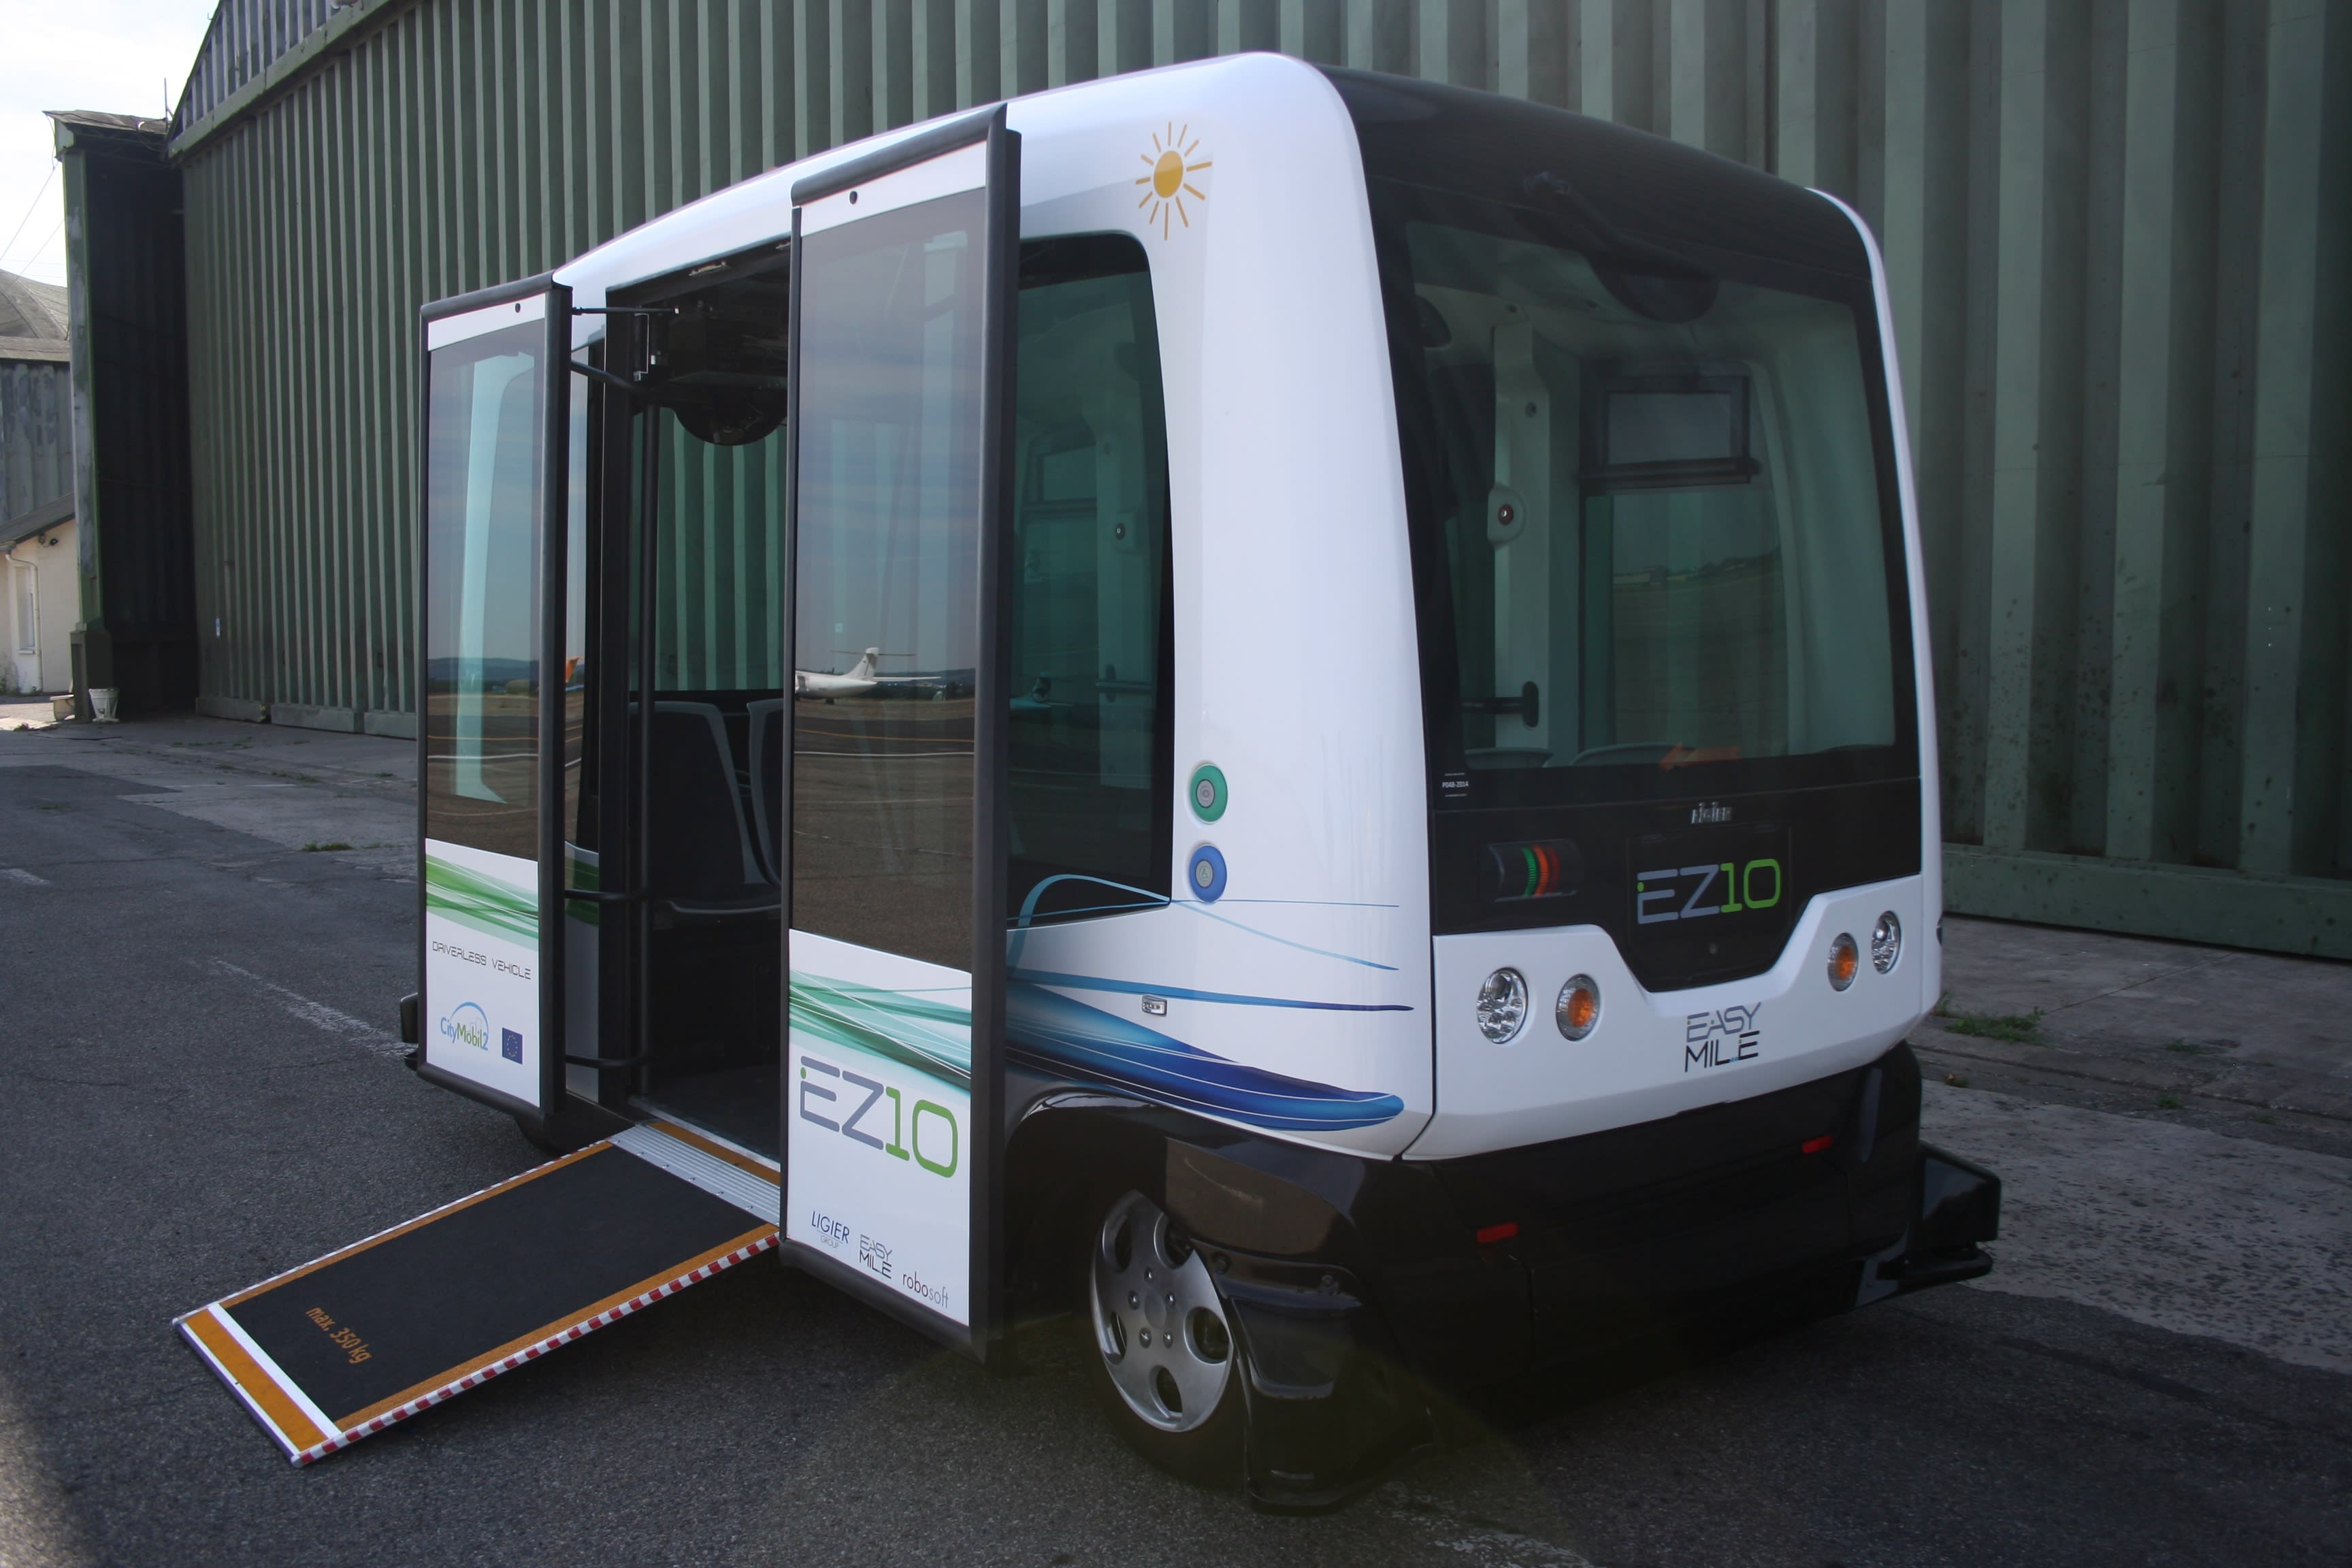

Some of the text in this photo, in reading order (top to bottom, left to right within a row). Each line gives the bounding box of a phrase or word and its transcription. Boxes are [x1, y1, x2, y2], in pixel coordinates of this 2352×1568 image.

[1637, 858, 1781, 925] EZ10
[432, 941, 532, 980] DRIVERLESS VEHICLE
[440, 1017, 489, 1051] CityMobil2
[1686, 1001, 1761, 1043] EASY
[1684, 1030, 1761, 1073] MILE
[800, 1056, 958, 1178] EZ10
[811, 1211, 850, 1244] LIGIER
[859, 1250, 892, 1279] MILE
[860, 1234, 893, 1262] EASY
[902, 1271, 949, 1309] robosoft
[329, 1327, 361, 1349] 350
[348, 1343, 372, 1365] kg
